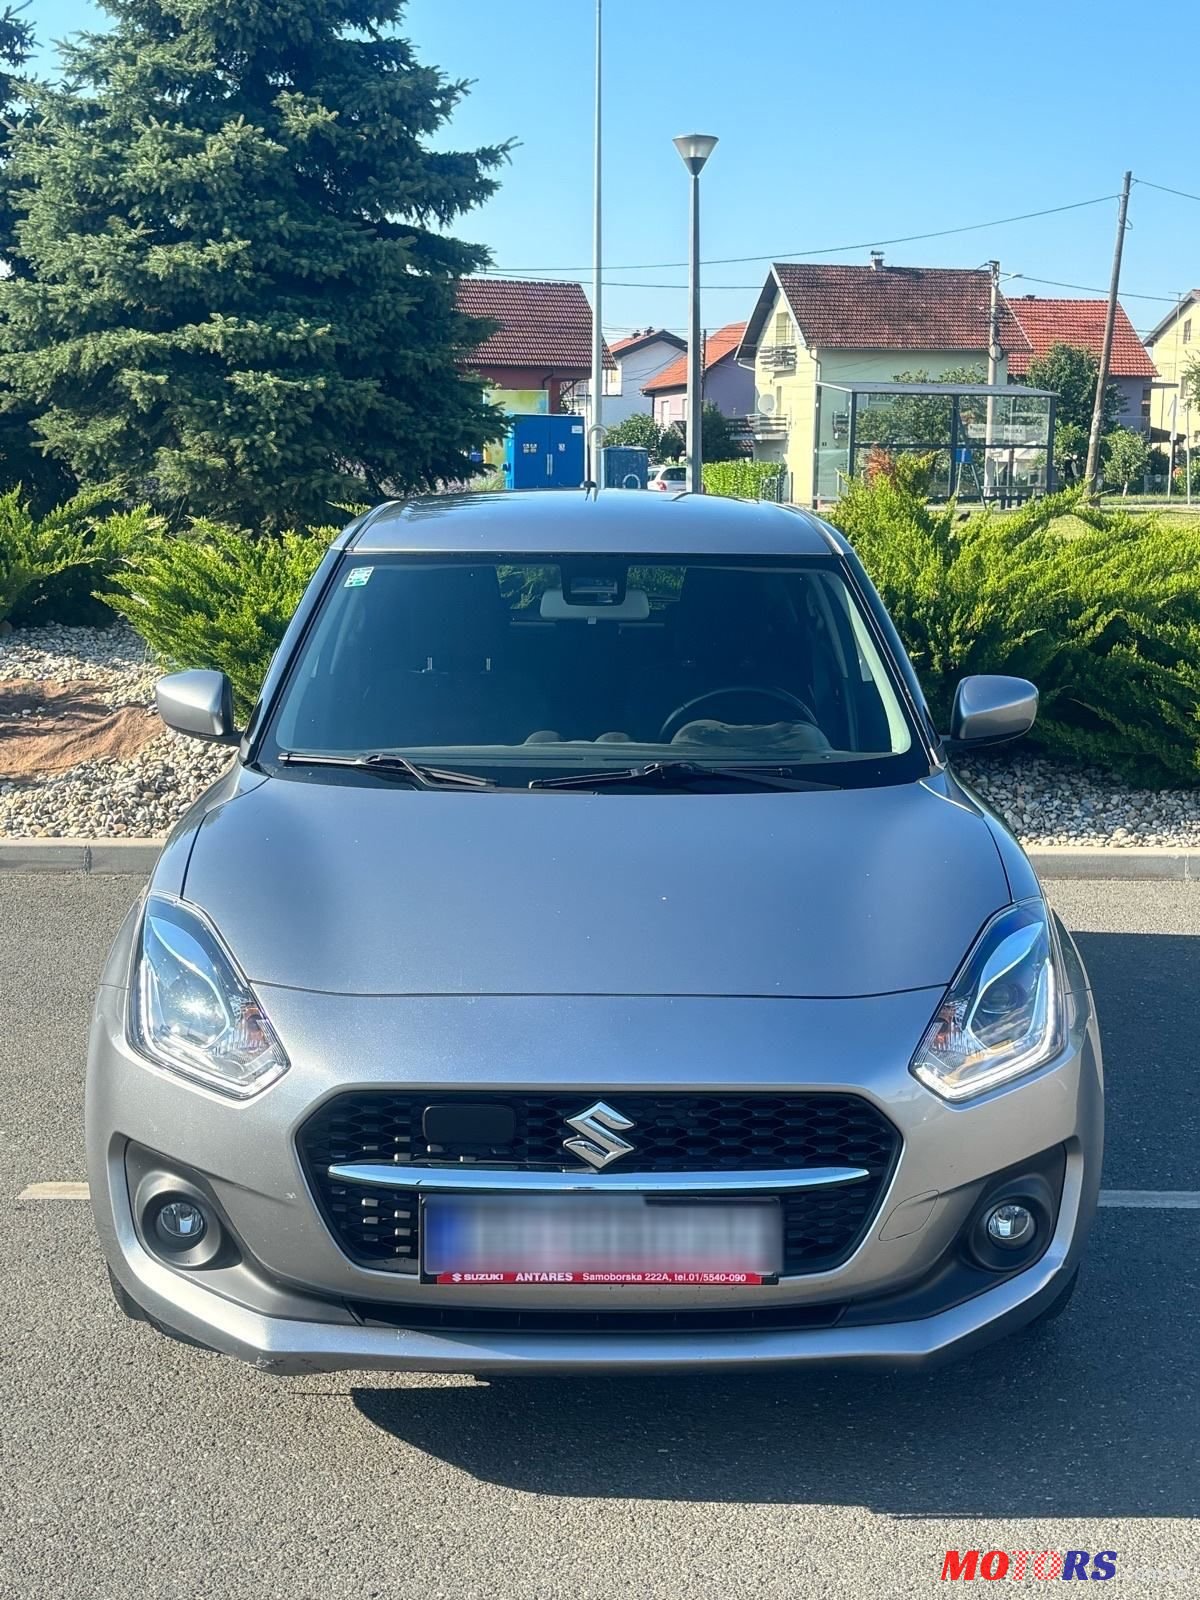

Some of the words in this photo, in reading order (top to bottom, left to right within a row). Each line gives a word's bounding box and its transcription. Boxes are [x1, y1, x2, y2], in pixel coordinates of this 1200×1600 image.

[463, 1273, 504, 1281] SUZUKI
[515, 1272, 573, 1282] ANTARES
[582, 1272, 642, 1282] Samoborska
[644, 1273, 672, 1283] 222A,
